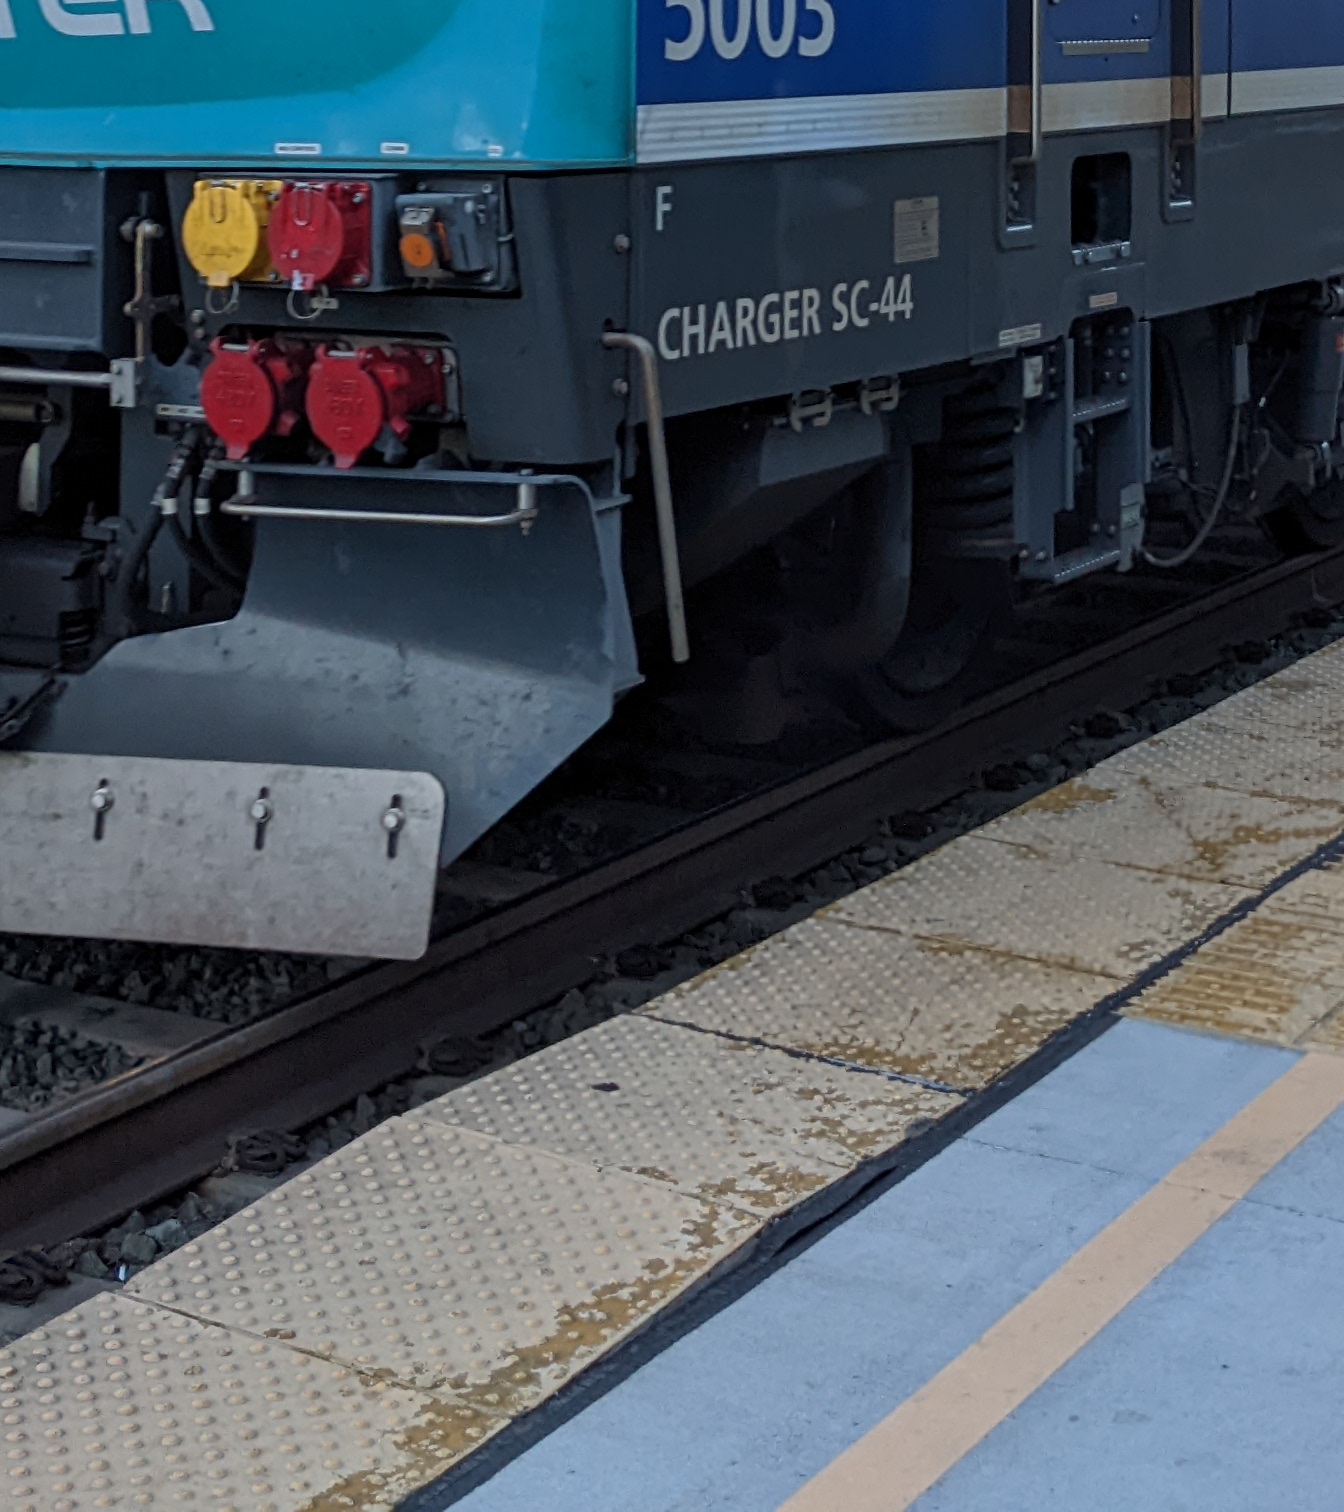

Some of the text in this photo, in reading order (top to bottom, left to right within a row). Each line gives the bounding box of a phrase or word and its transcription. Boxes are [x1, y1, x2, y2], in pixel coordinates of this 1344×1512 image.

[656, 185, 673, 231] F
[657, 273, 914, 361] CHARGER SC-44
